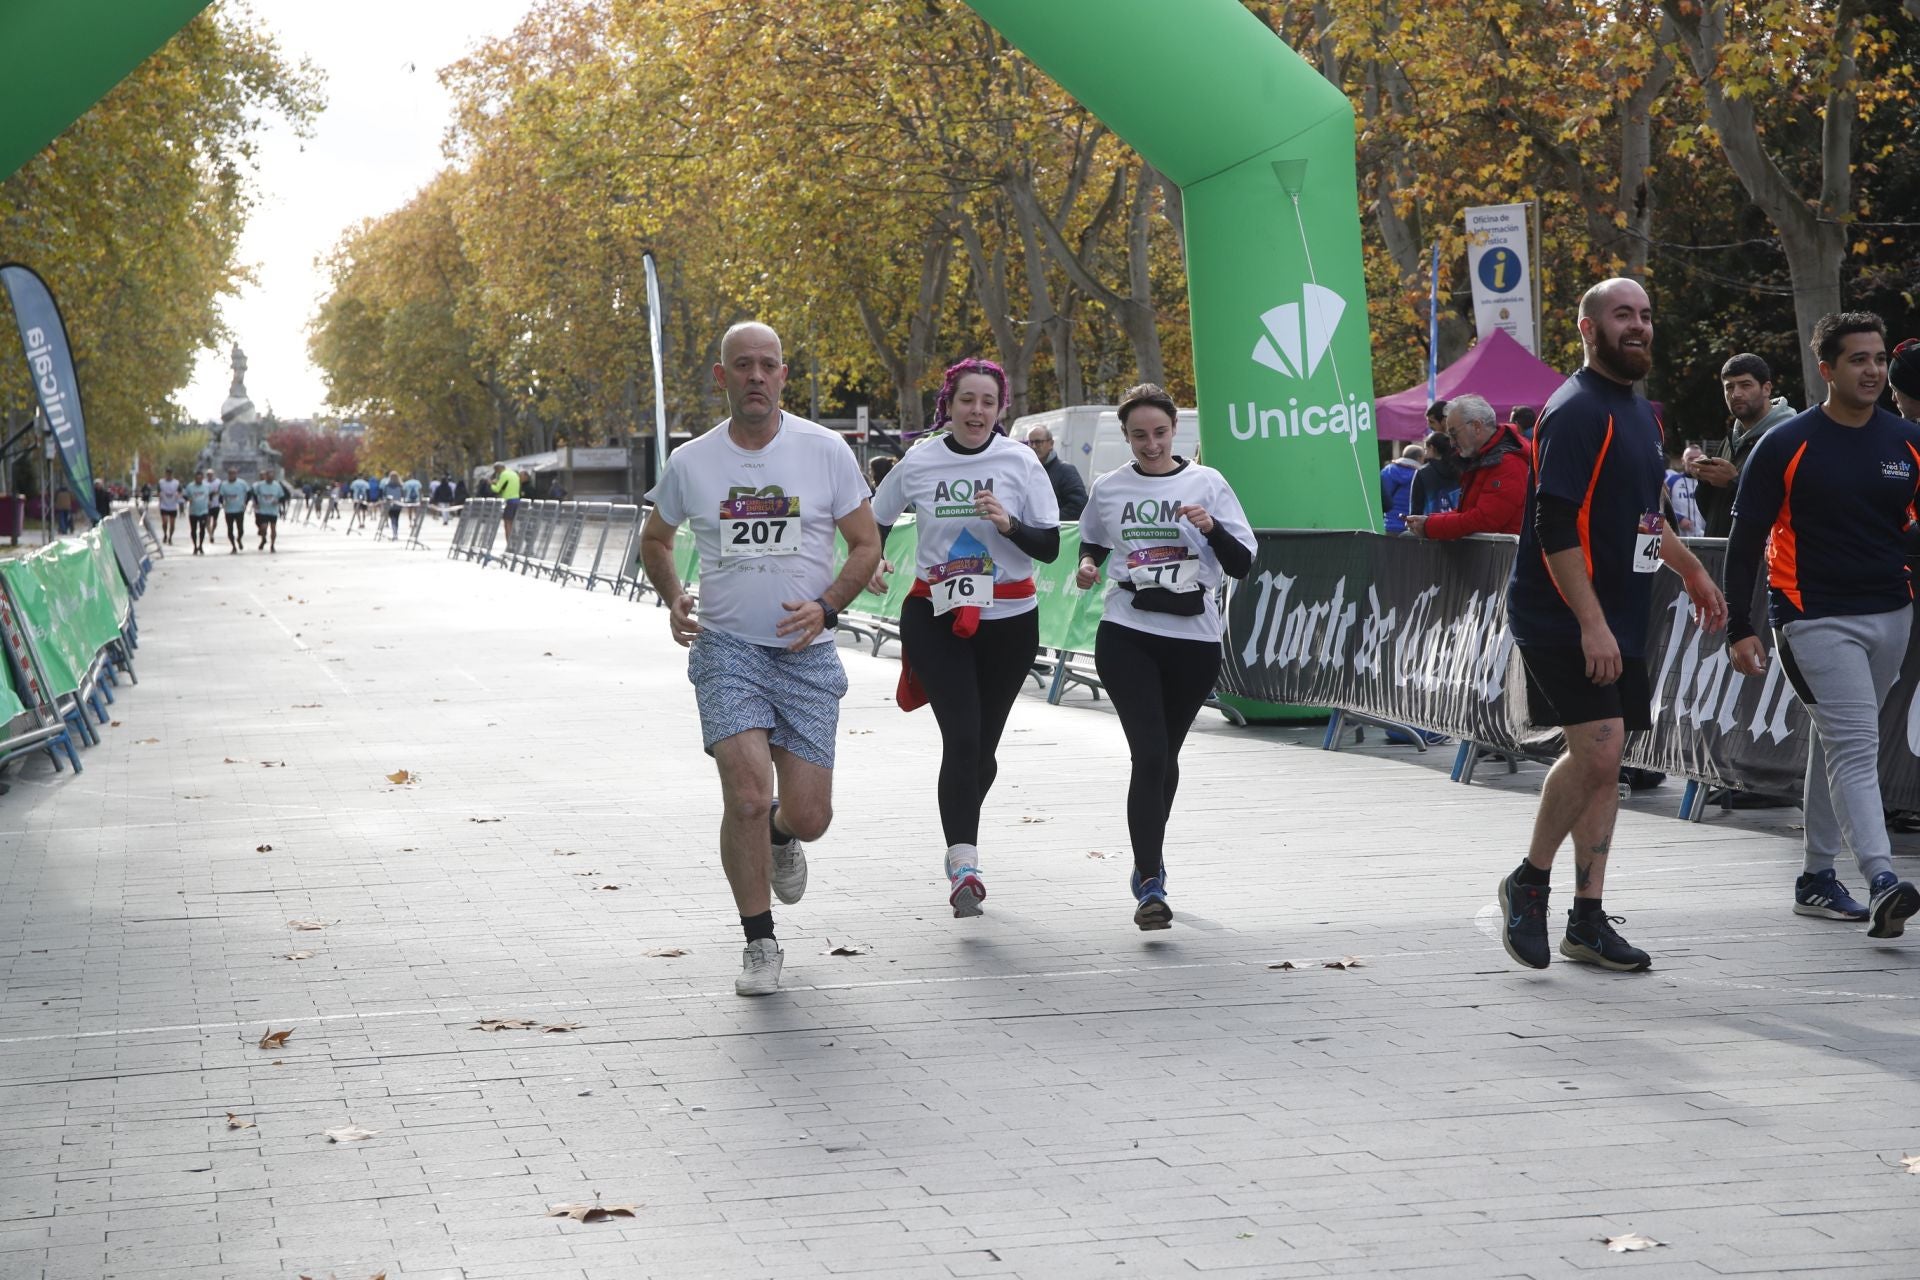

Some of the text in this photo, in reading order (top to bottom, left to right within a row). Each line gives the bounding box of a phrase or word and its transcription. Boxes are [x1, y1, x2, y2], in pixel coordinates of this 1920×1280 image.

[1473, 214, 1509, 224] Oficina de
[1229, 393, 1371, 443] Unicaja
[934, 478, 994, 503] AQM
[1121, 500, 1181, 526] AQM
[732, 521, 788, 545] 207
[1124, 530, 1177, 538] LABORATORIOS
[1148, 563, 1180, 584] 77
[945, 577, 974, 600] 76
[1242, 570, 1356, 672] Norte
[1354, 582, 1396, 680] de
